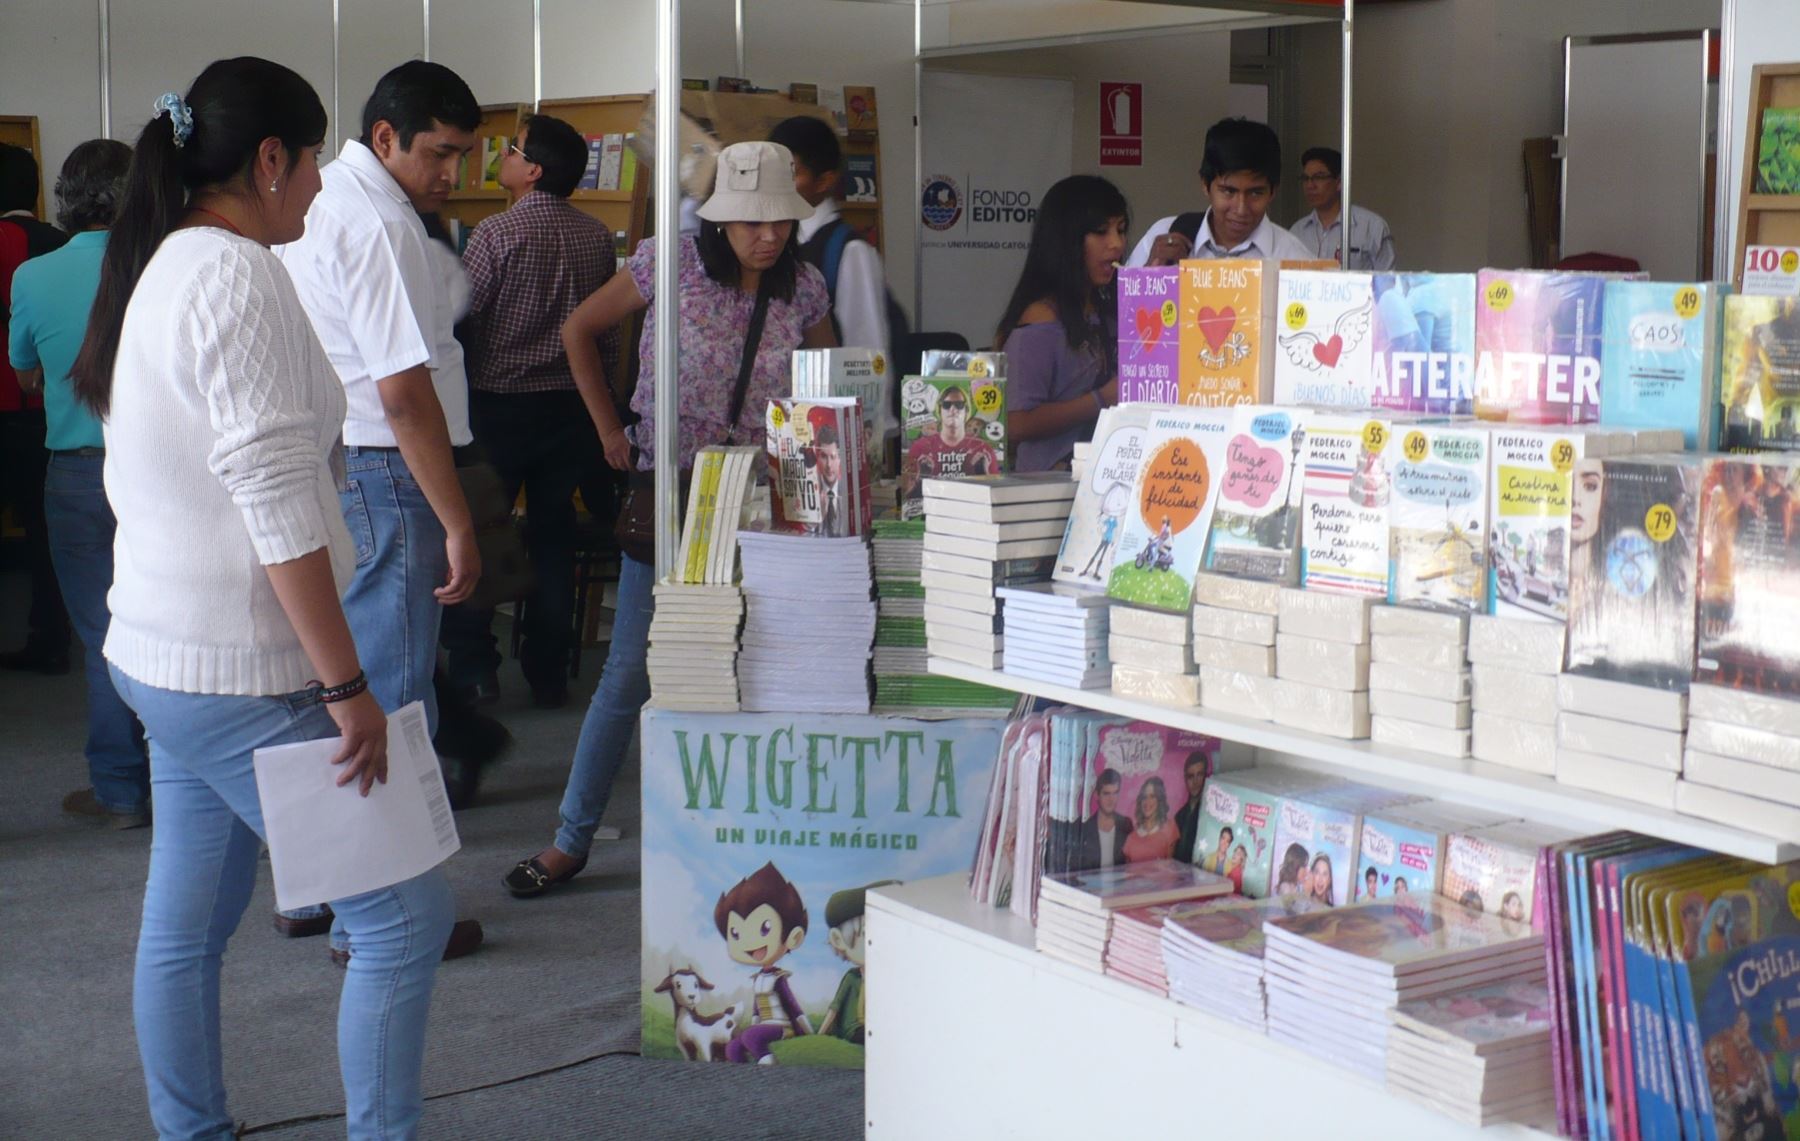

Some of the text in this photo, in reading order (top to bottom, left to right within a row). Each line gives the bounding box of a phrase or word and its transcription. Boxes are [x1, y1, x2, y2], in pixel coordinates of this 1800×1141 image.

[1102, 148, 1140, 157] EXTINTOR
[973, 189, 1031, 207] FONDO
[973, 206, 1037, 222] EDITOR
[947, 240, 1000, 249] UNIVERSIDAD
[1123, 276, 1168, 296] BLUE JEANS
[1191, 267, 1248, 288] BLUE JEANS
[1287, 279, 1351, 300] BLUE JEANS
[1681, 292, 1698, 310] 49
[1122, 363, 1169, 378] TENGO UN SECRETO
[1372, 351, 1474, 400] AFTER
[1474, 350, 1601, 405] AFTER
[981, 389, 998, 406] 39
[1121, 379, 1179, 404] EL DIARIO
[1155, 419, 1225, 433] FEDERICO MOCCIA
[1128, 436, 1140, 447] EL
[1309, 437, 1353, 449] FEDERICO
[1369, 426, 1383, 445] 55
[1433, 439, 1480, 450] FEDERICO
[1497, 436, 1543, 449] FEDERICO
[1410, 436, 1426, 454] 49
[1558, 444, 1573, 463] 59
[937, 451, 967, 463] Inter
[1170, 447, 1189, 467] Ese
[1231, 443, 1267, 473] Tengo
[1310, 450, 1347, 462] MOCCIA
[1443, 450, 1480, 460] MOCCIA
[1506, 452, 1544, 463] MOCCIA
[782, 458, 807, 481] MAGO
[942, 462, 963, 472] net
[1101, 467, 1137, 482] PALABR
[1152, 469, 1203, 484] instante
[1228, 470, 1260, 488] ganas
[1508, 475, 1560, 493] Carolina
[1167, 482, 1184, 495] de
[1145, 489, 1200, 513] felicidad
[1654, 511, 1672, 531] 79
[1310, 545, 1355, 568] contigo
[672, 723, 962, 819] WIGETTA
[715, 825, 918, 850] UN VIAJE MÁGICO
[1727, 948, 1800, 1007] ¡CHILL
